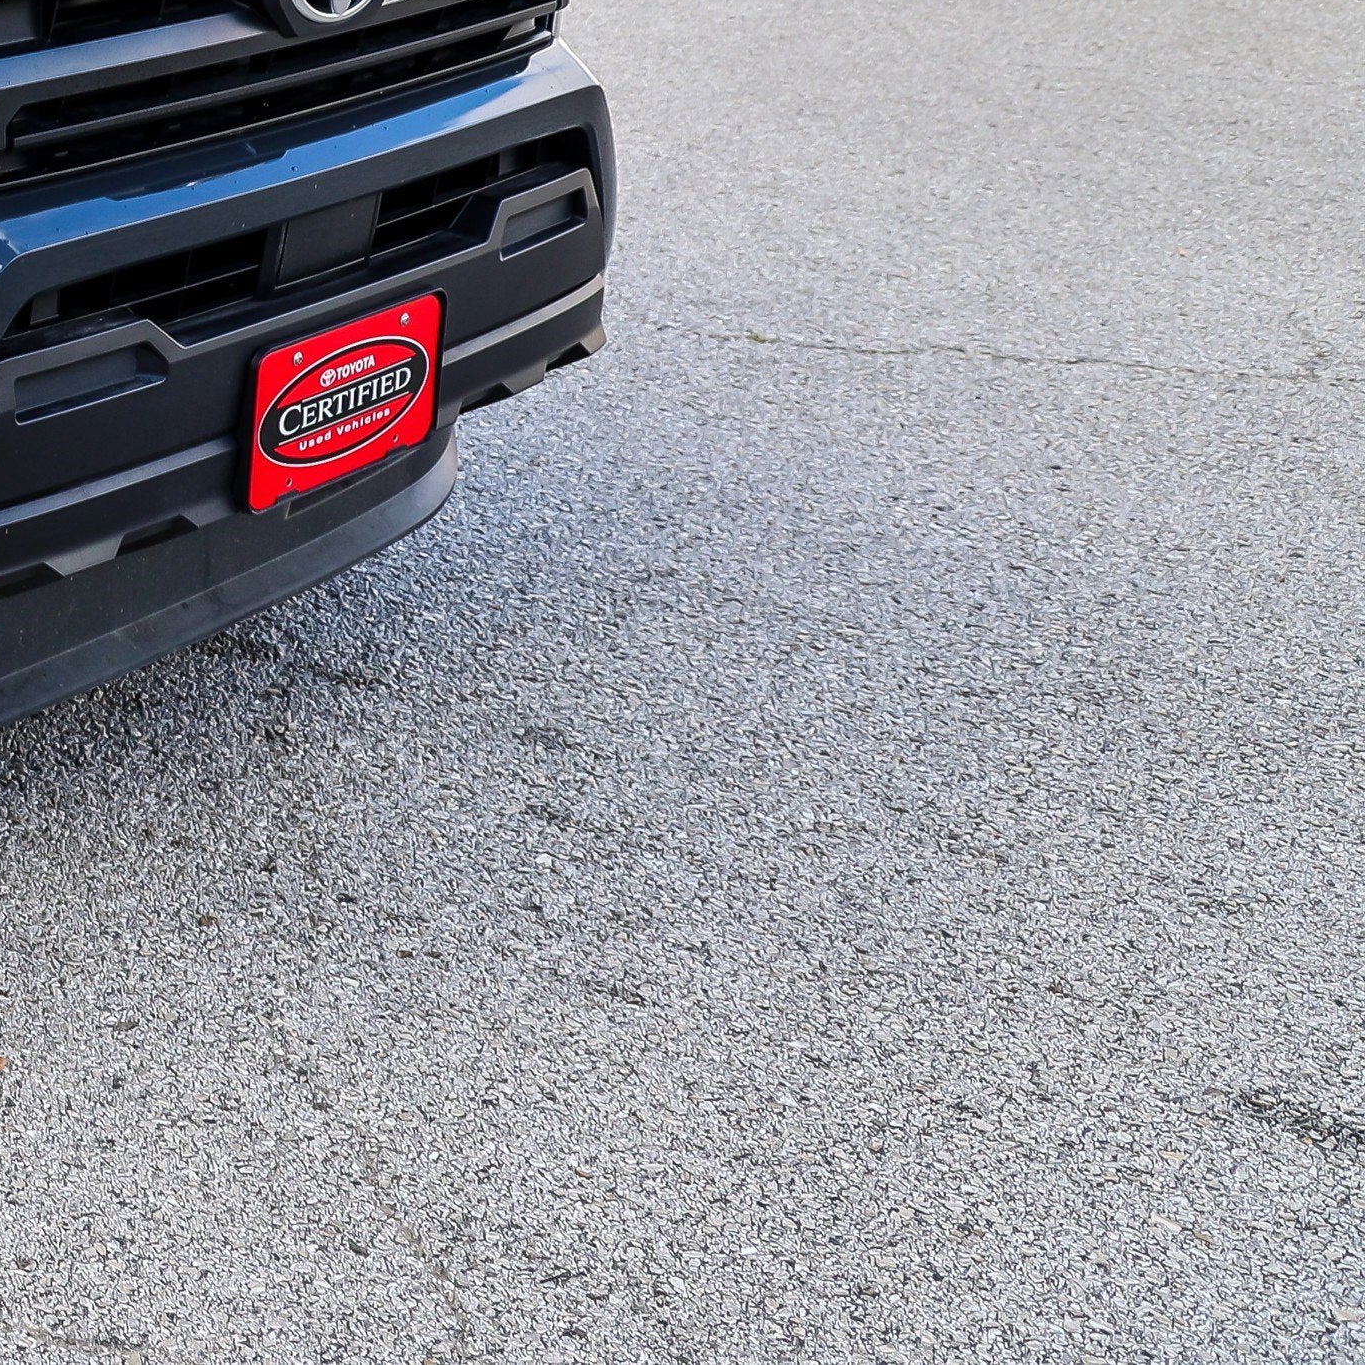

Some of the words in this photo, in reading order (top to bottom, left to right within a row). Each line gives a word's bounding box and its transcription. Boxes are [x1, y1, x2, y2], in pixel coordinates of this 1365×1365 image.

[336, 355, 376, 380] TOYOTA
[278, 367, 412, 436] CERTIFIED
[299, 431, 332, 451] Used
[336, 408, 391, 436] Vehicles
